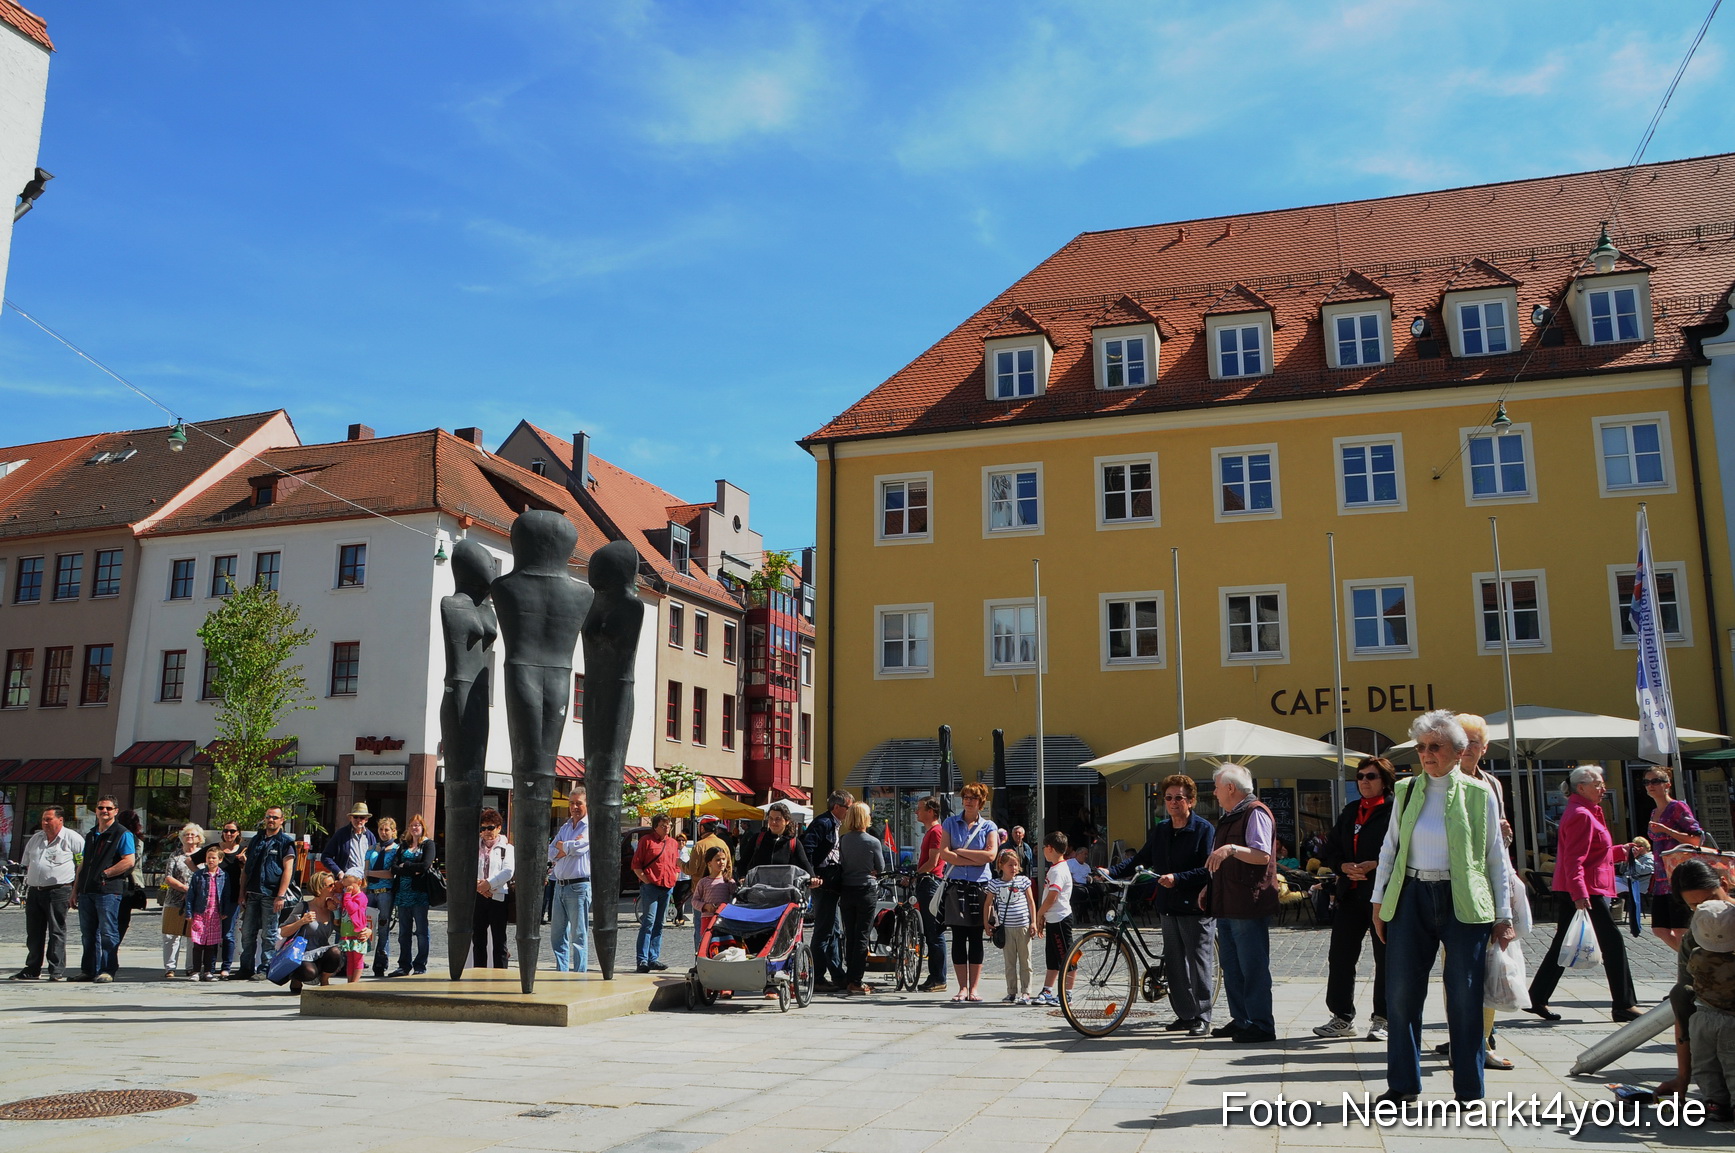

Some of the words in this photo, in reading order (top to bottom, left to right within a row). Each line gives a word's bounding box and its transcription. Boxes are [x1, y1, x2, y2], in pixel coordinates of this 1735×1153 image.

[1270, 687, 1351, 716] CAFE
[1367, 683, 1435, 713] DELI
[355, 736, 405, 755] Döpfer
